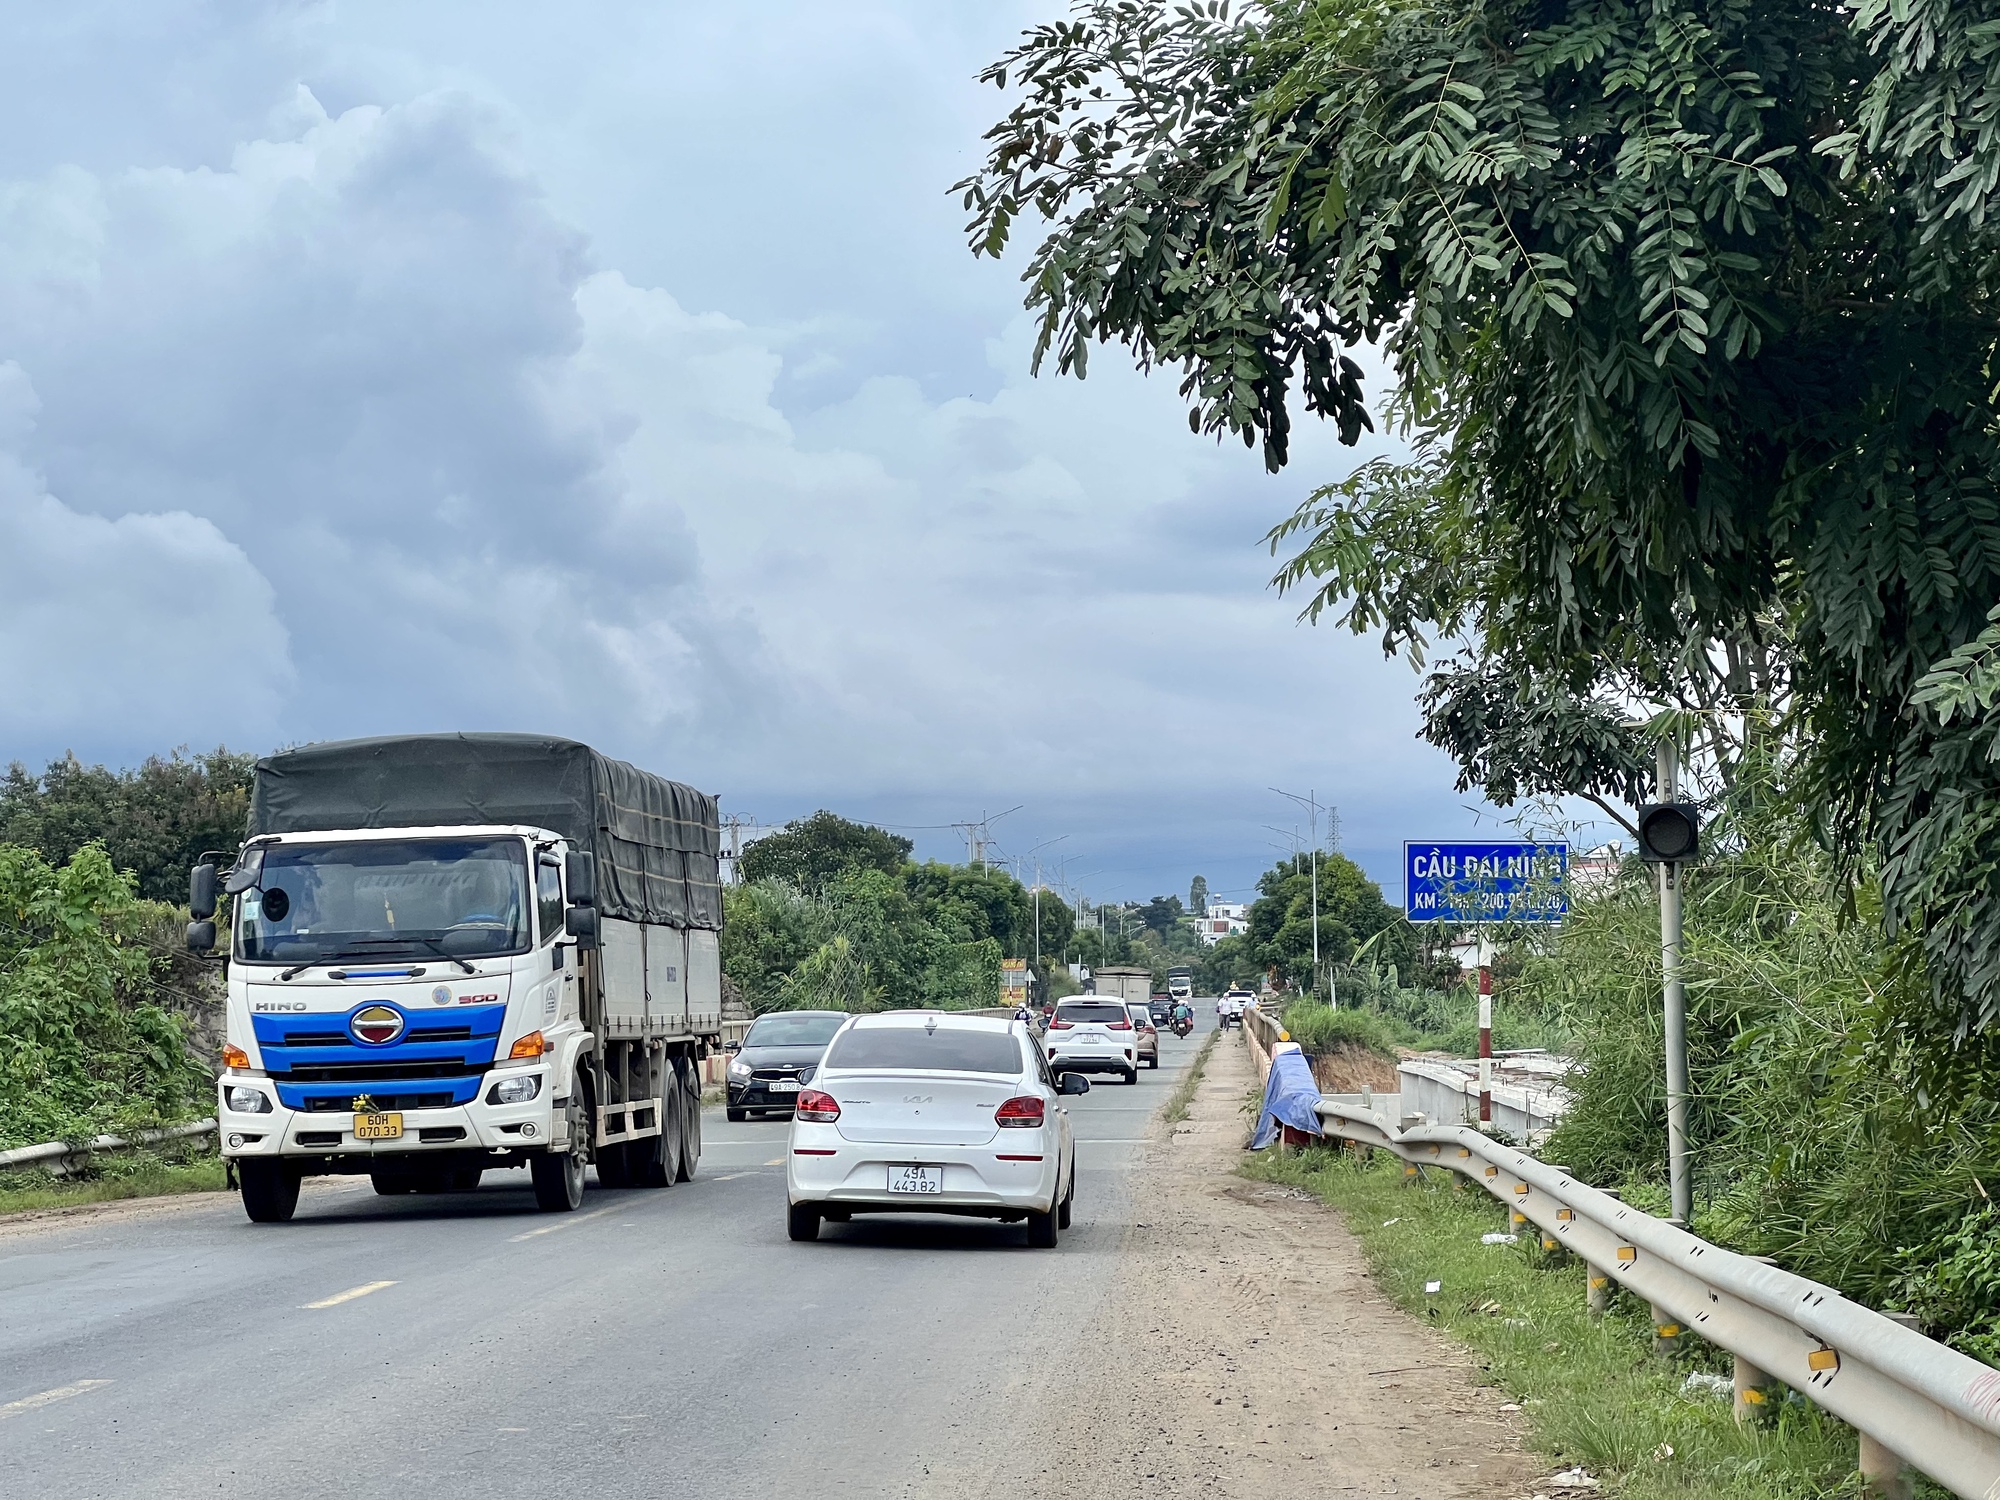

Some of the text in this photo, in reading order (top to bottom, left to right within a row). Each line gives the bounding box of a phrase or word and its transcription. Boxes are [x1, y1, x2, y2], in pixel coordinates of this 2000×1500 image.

[1413, 847, 1456, 879] CẦU
[459, 994, 498, 1005] 500
[255, 1002, 307, 1011] HINO
[367, 1114, 389, 1126] 60H
[359, 1126, 398, 1138] 070.33
[904, 1167, 927, 1180] 49A
[893, 1179, 936, 1193] 443.82
